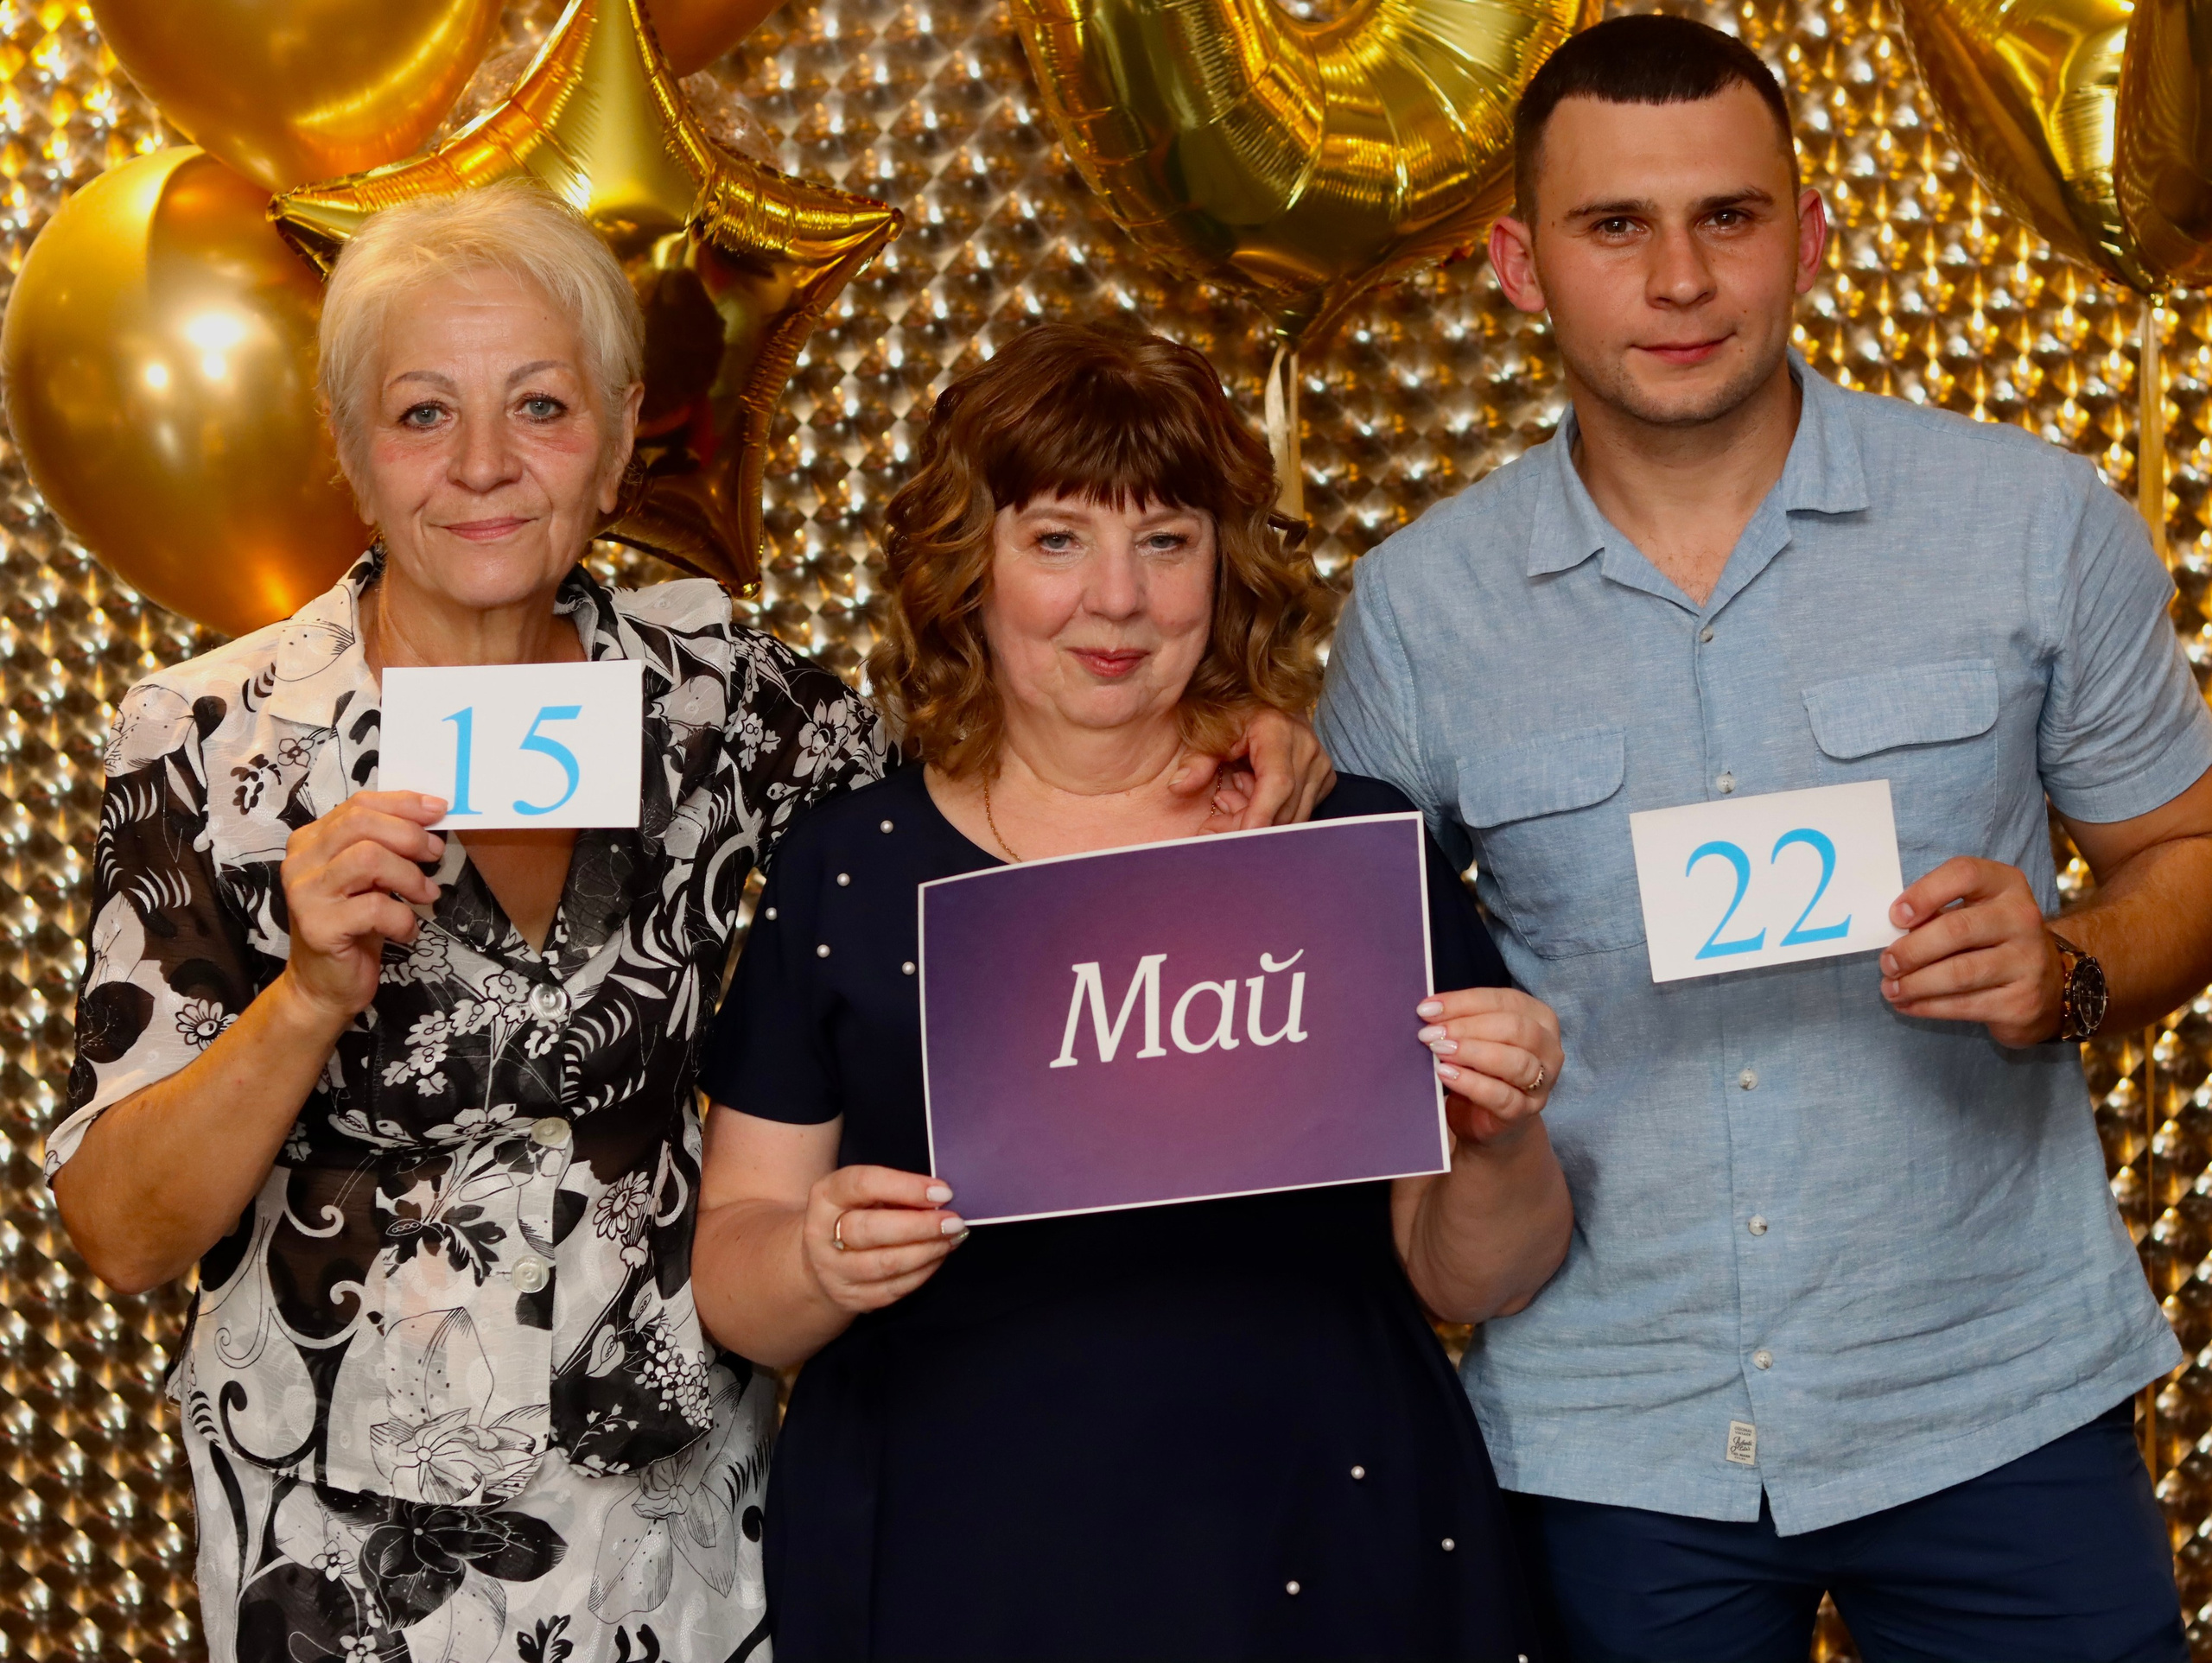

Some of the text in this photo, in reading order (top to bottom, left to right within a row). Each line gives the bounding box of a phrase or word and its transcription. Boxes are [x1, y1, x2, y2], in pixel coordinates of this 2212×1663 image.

[442, 705, 582, 816] 15
[1686, 828, 1852, 960] 22
[1049, 948, 1308, 1069] Май
